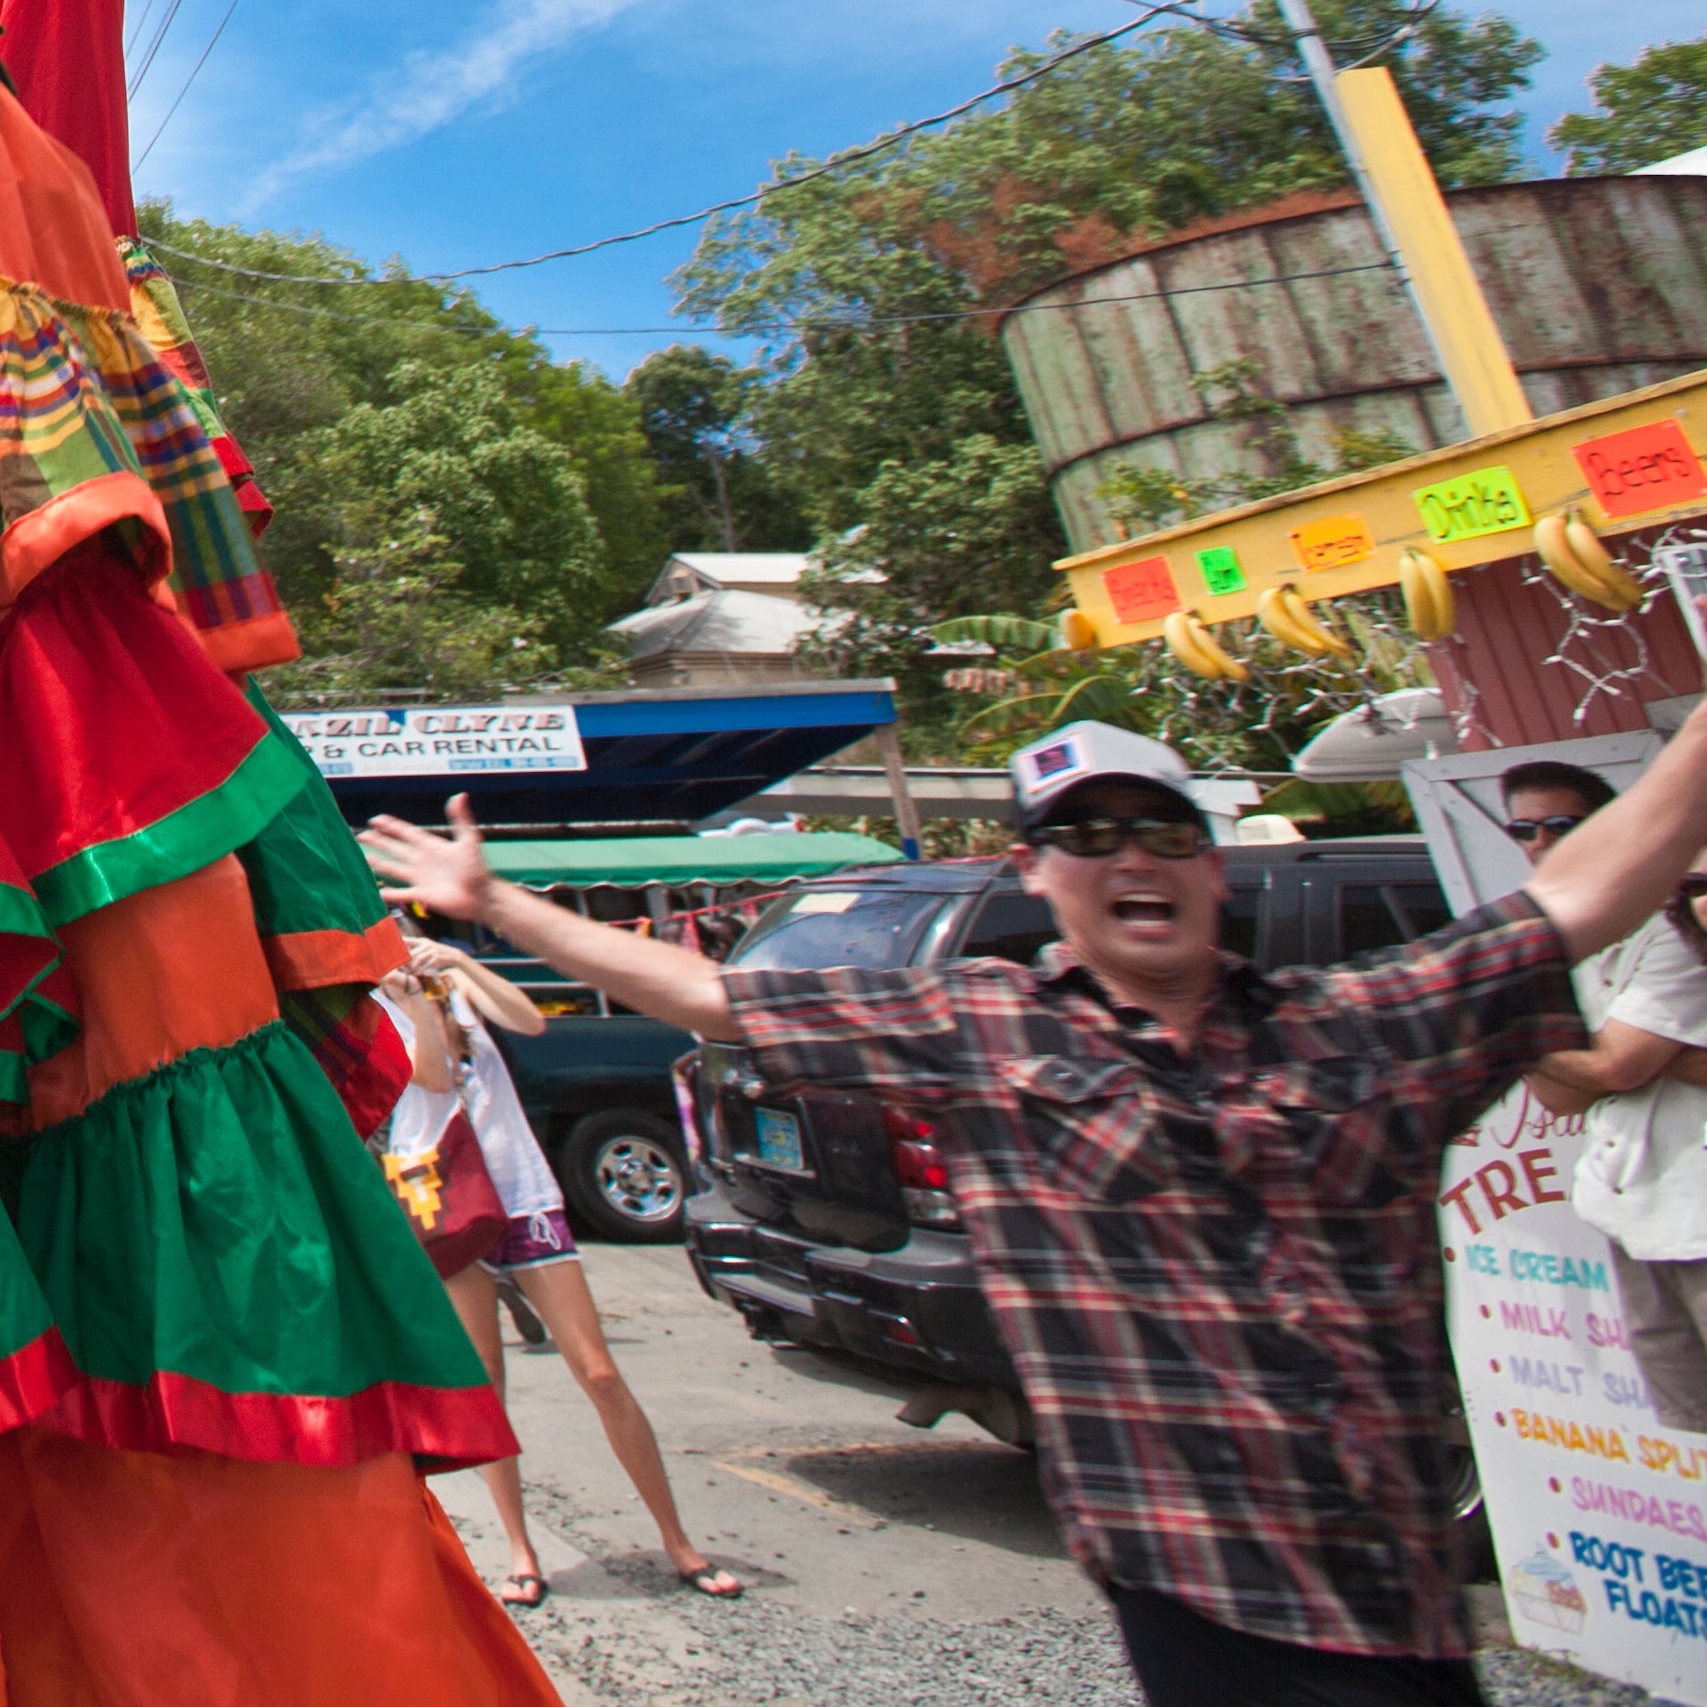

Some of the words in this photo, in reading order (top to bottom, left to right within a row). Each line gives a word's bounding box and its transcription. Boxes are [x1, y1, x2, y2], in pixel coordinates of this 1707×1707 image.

[1587, 446, 1691, 497] Beers
[1421, 481, 1517, 539] Drinks
[284, 716, 402, 738] AZIL
[413, 712, 566, 735] CLYNE
[323, 744, 346, 759] &
[357, 741, 424, 758] CAR
[432, 736, 562, 755] RENTAL
[1439, 1148, 1572, 1236] TRE
[1464, 1244, 1502, 1277] ICE
[1509, 1249, 1611, 1293] CREAM
[1499, 1299, 1573, 1342] MILK
[1508, 1355, 1585, 1397] MALT
[1510, 1407, 1631, 1464] BANANA
[1570, 1476, 1707, 1543] SUNDAES
[1567, 1530, 1645, 1583] ROOT
